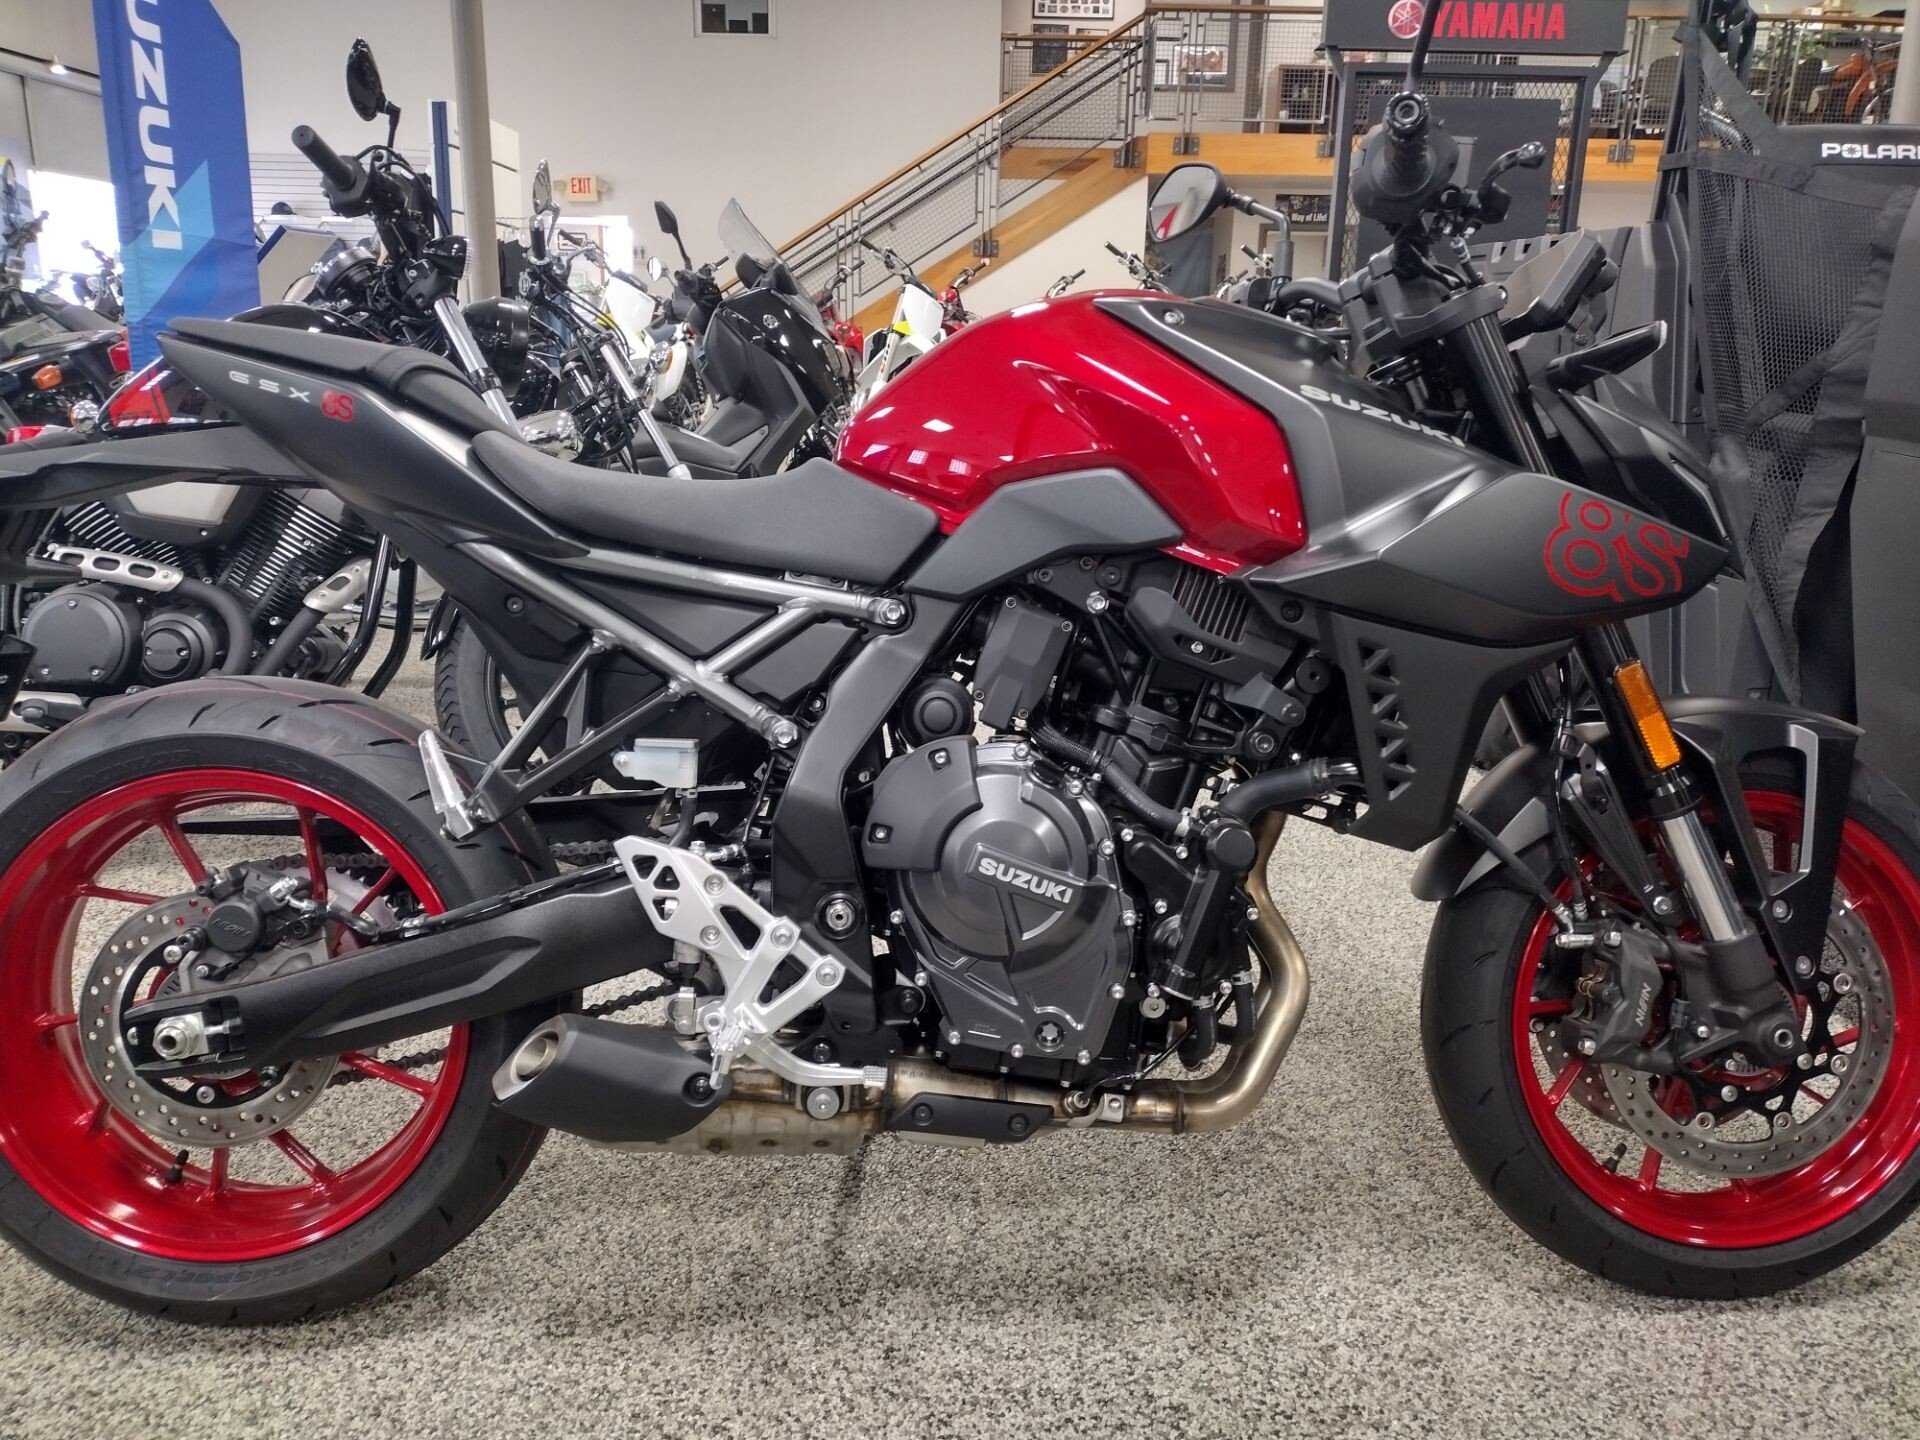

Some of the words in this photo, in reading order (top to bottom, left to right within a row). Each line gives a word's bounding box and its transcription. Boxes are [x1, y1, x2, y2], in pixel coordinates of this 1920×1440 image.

[1432, 2, 1566, 39] YAMAHA
[571, 177, 592, 194] EXIT
[1291, 213, 1305, 223] Way
[1305, 213, 1312, 222] of
[1300, 384, 1466, 448] SUZUKI
[978, 857, 1073, 904] SUZUKI
